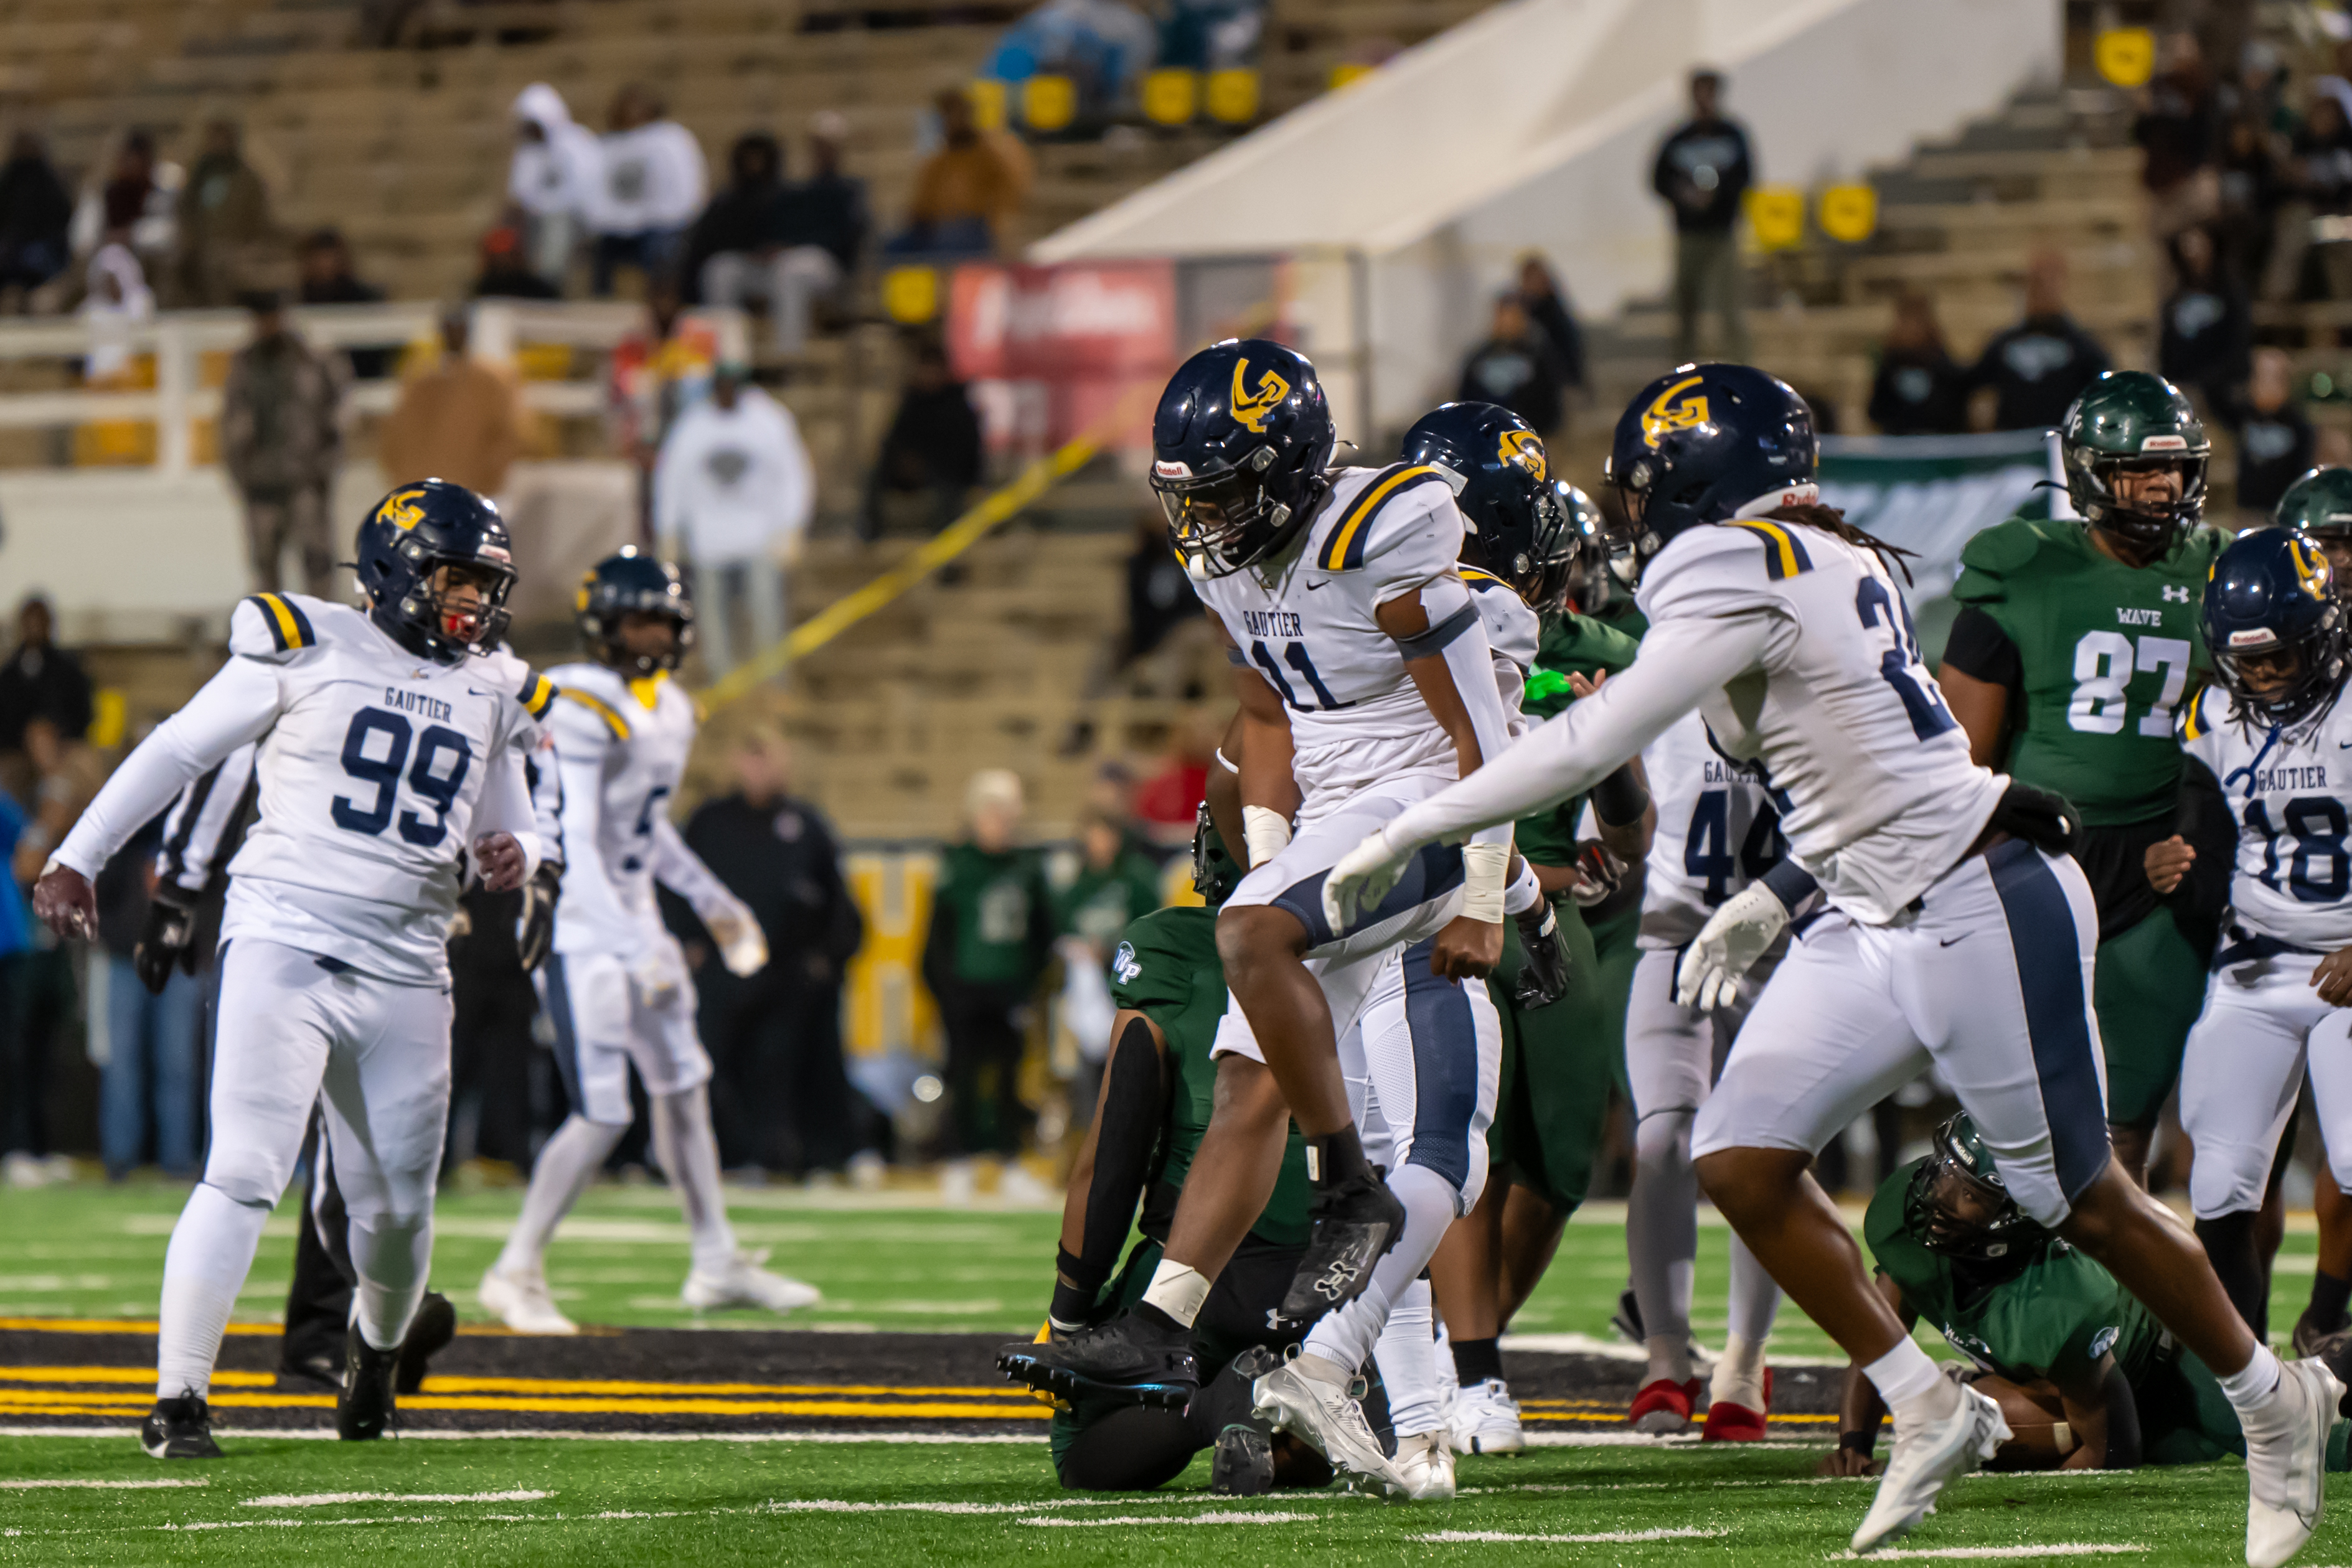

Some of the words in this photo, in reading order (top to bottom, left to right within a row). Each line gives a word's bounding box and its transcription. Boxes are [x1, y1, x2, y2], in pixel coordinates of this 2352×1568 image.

[1243, 611, 1304, 637] GAUTIER
[2117, 608, 2162, 627] WAVE
[1251, 640, 1357, 713] 11
[2067, 631, 2191, 738] 87
[384, 687, 452, 723] GAUTIER
[331, 706, 473, 847] 99
[2259, 766, 2327, 792] GAUTIER
[2244, 796, 2350, 901] 18
[1113, 946, 1142, 985] WP
